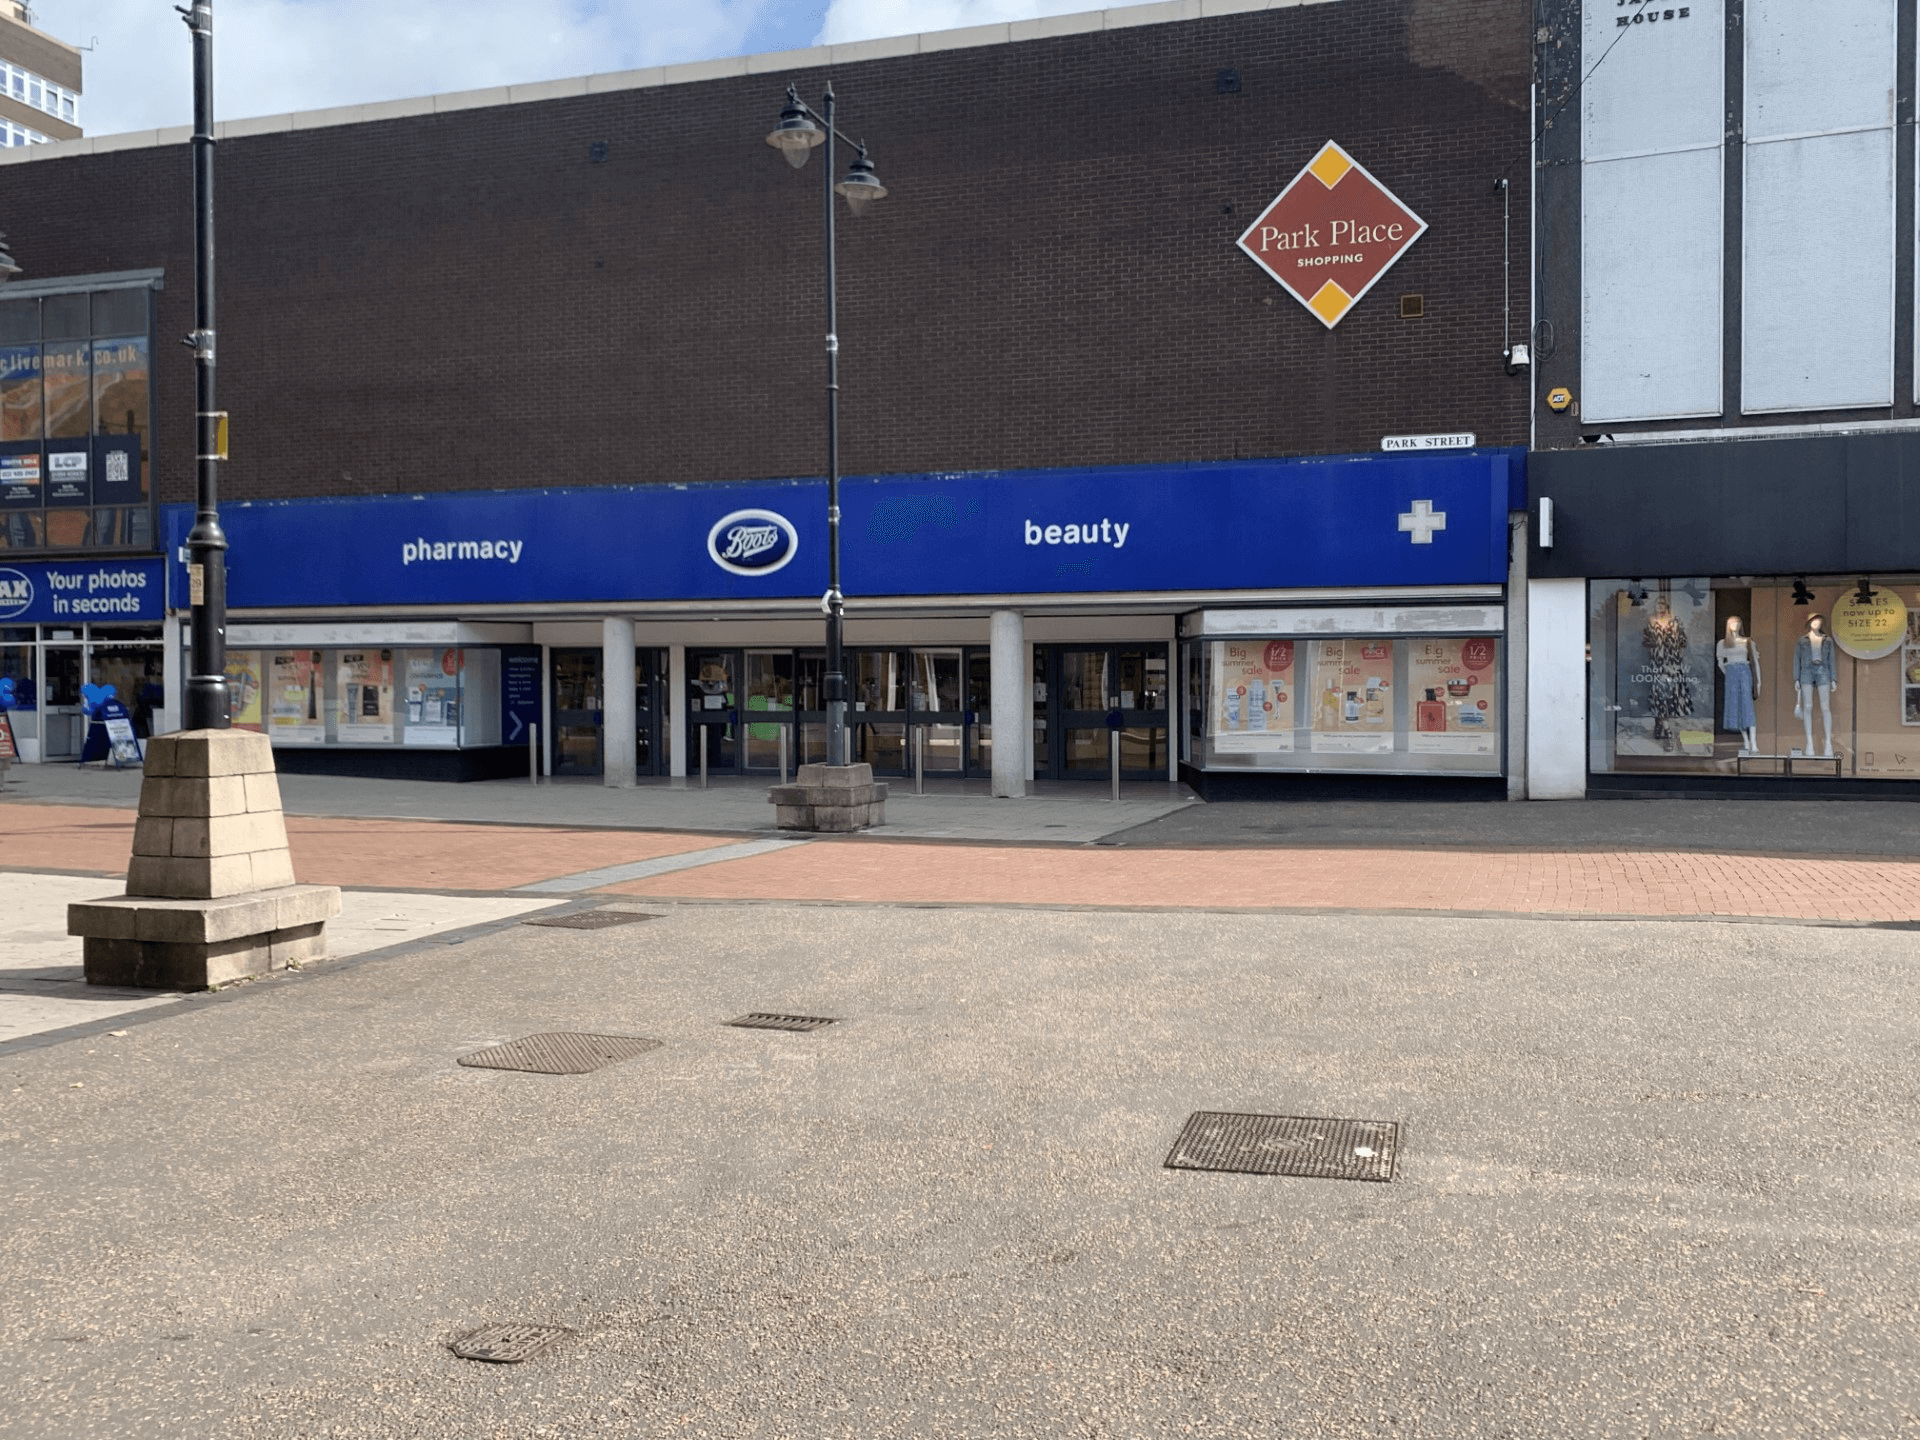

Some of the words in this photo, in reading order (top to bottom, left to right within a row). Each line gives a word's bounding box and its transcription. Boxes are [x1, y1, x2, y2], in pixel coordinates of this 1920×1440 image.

[1616, 7, 1690, 27] HOUSE
[1260, 223, 1320, 252] Park
[1329, 219, 1403, 246] Place
[1297, 253, 1364, 268] SHOPPING
[1386, 438, 1417, 448] PARK
[1425, 436, 1471, 447] STREET
[1024, 517, 1130, 549] beauty
[722, 525, 778, 559] Boots
[403, 537, 523, 566] pharmacy
[46, 571, 84, 590] Your
[88, 568, 146, 594] photos
[53, 594, 69, 613] in
[72, 592, 140, 613] seconds
[1843, 609, 1865, 617] now
[1868, 609, 1882, 618] up
[1848, 618, 1871, 627] SIZE
[1229, 646, 1247, 660] Big
[1271, 647, 1287, 657] 1/2
[1326, 646, 1343, 660] Big
[1425, 644, 1443, 658] Big
[1469, 645, 1487, 656] 1/2
[1241, 665, 1263, 675] sale
[1338, 665, 1361, 675] sale
[1438, 664, 1461, 674] sale
[1631, 674, 1661, 683] LOOK
